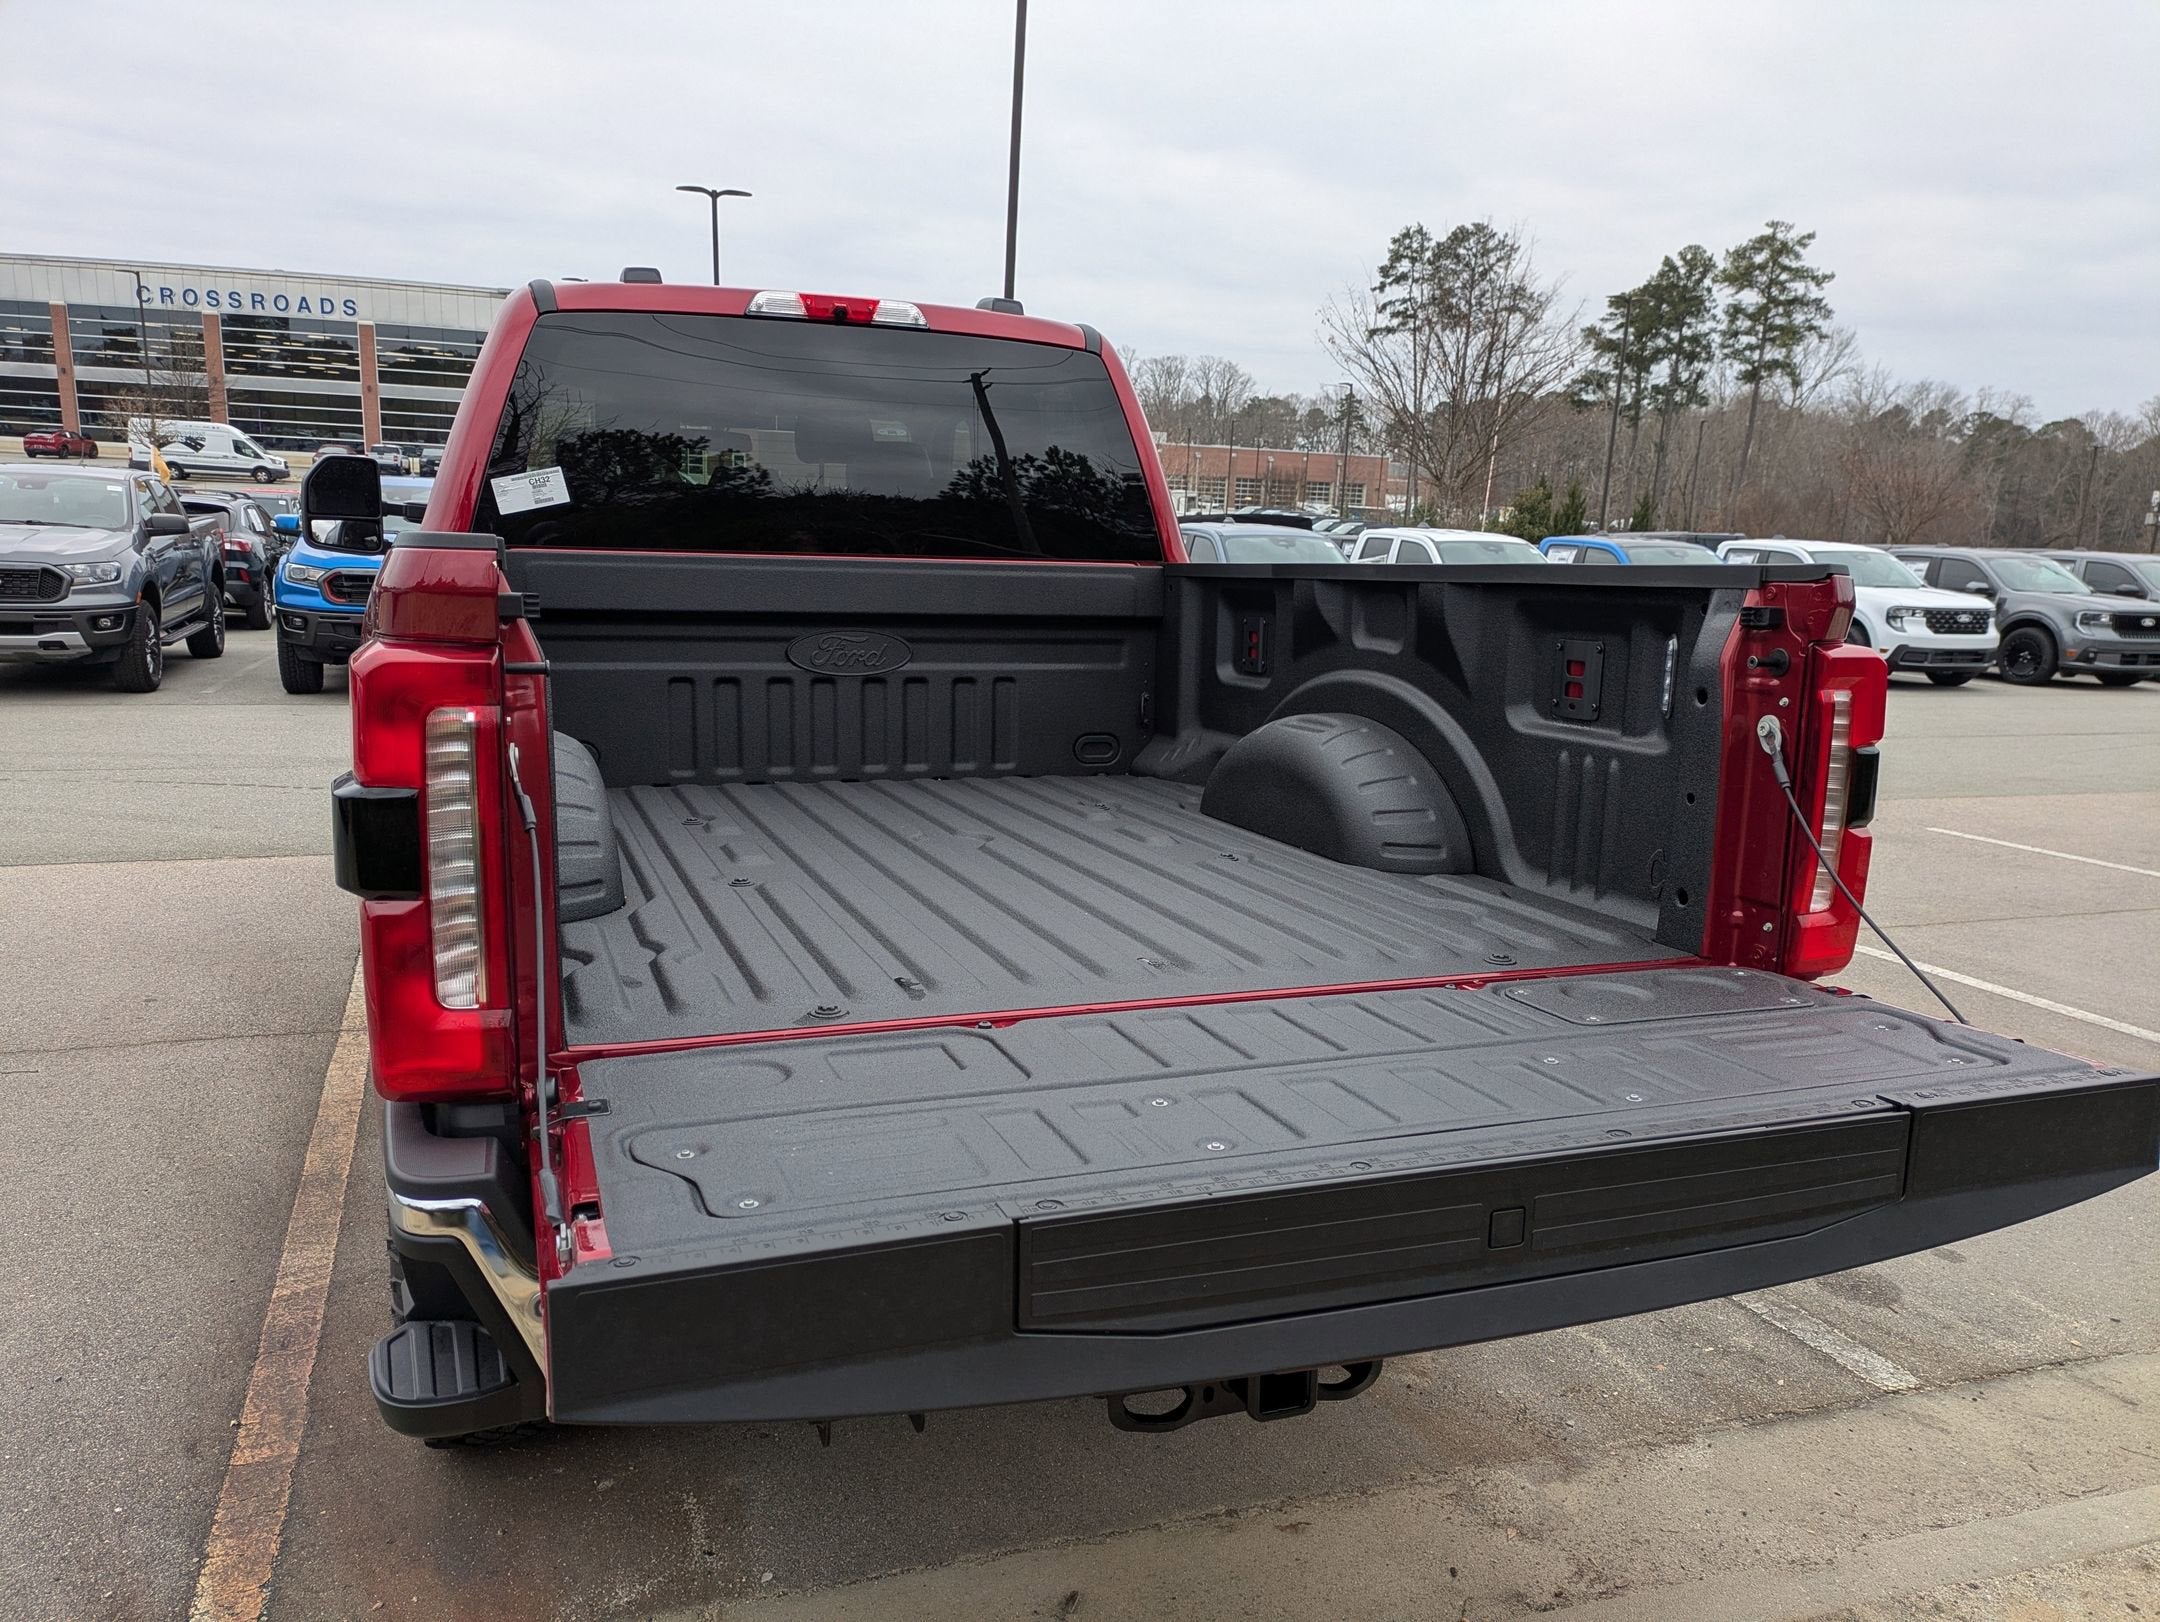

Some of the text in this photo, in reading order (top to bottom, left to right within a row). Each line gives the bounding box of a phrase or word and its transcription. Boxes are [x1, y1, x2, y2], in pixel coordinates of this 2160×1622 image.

[136, 285, 358, 316] CROSSROADS
[528, 475, 551, 486] CH32
[810, 634, 888, 666] Ford
